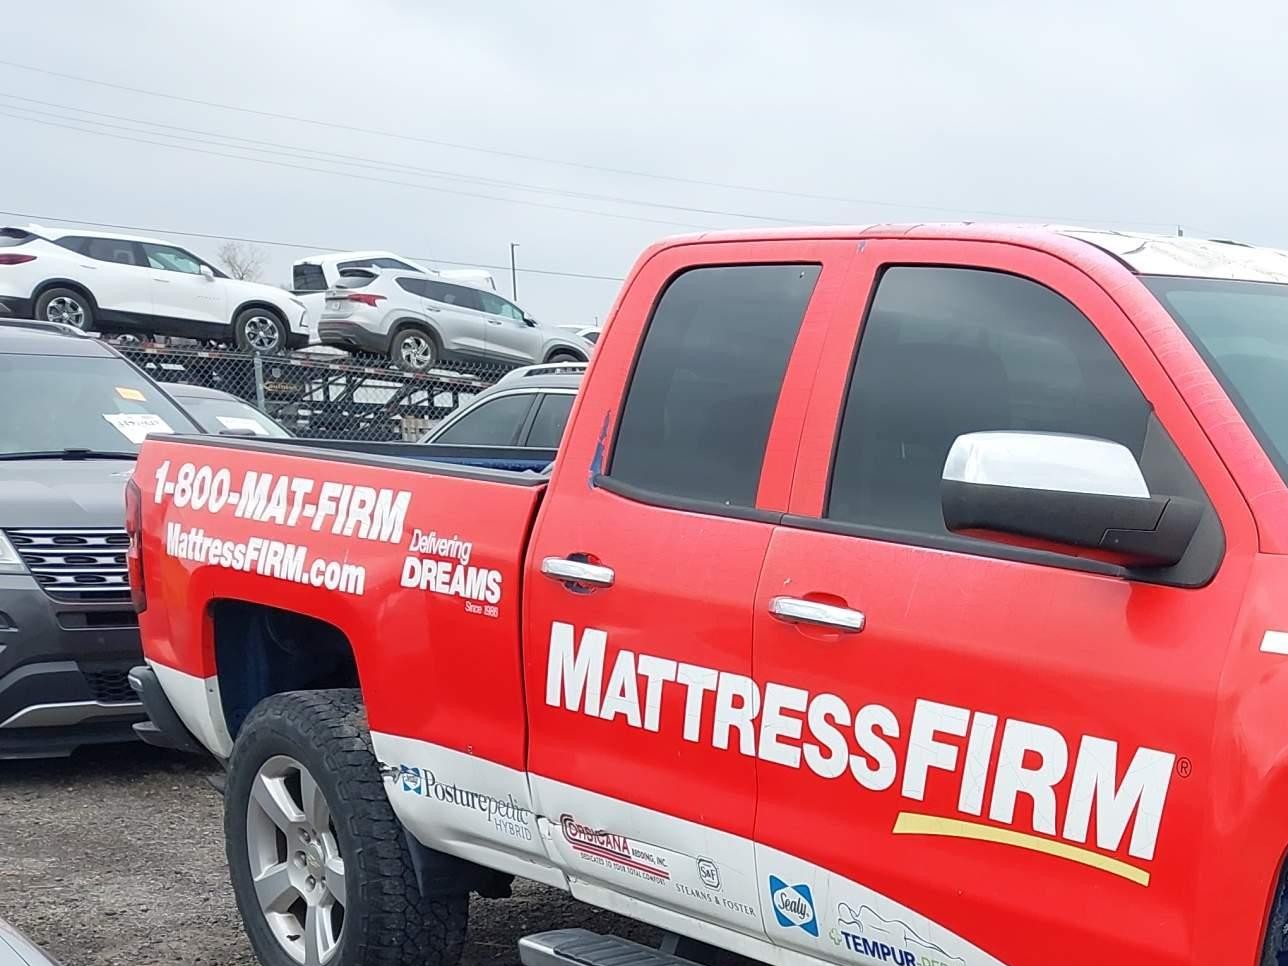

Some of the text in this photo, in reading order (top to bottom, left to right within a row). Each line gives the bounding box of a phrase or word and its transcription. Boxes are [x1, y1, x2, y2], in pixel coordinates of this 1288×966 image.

[154, 460, 412, 544] 1-800-MAT-FIRM
[166, 521, 366, 595] MattressFIRM.com
[409, 529, 472, 565] Delivering
[401, 556, 502, 604] DREAMS
[465, 601, 482, 614] Since
[422, 768, 529, 825] Posturepedic
[494, 817, 532, 841] HYBRID
[675, 882, 712, 902] STEARNS
[722, 898, 756, 917] FOSTER
[778, 892, 807, 920] Sealy
